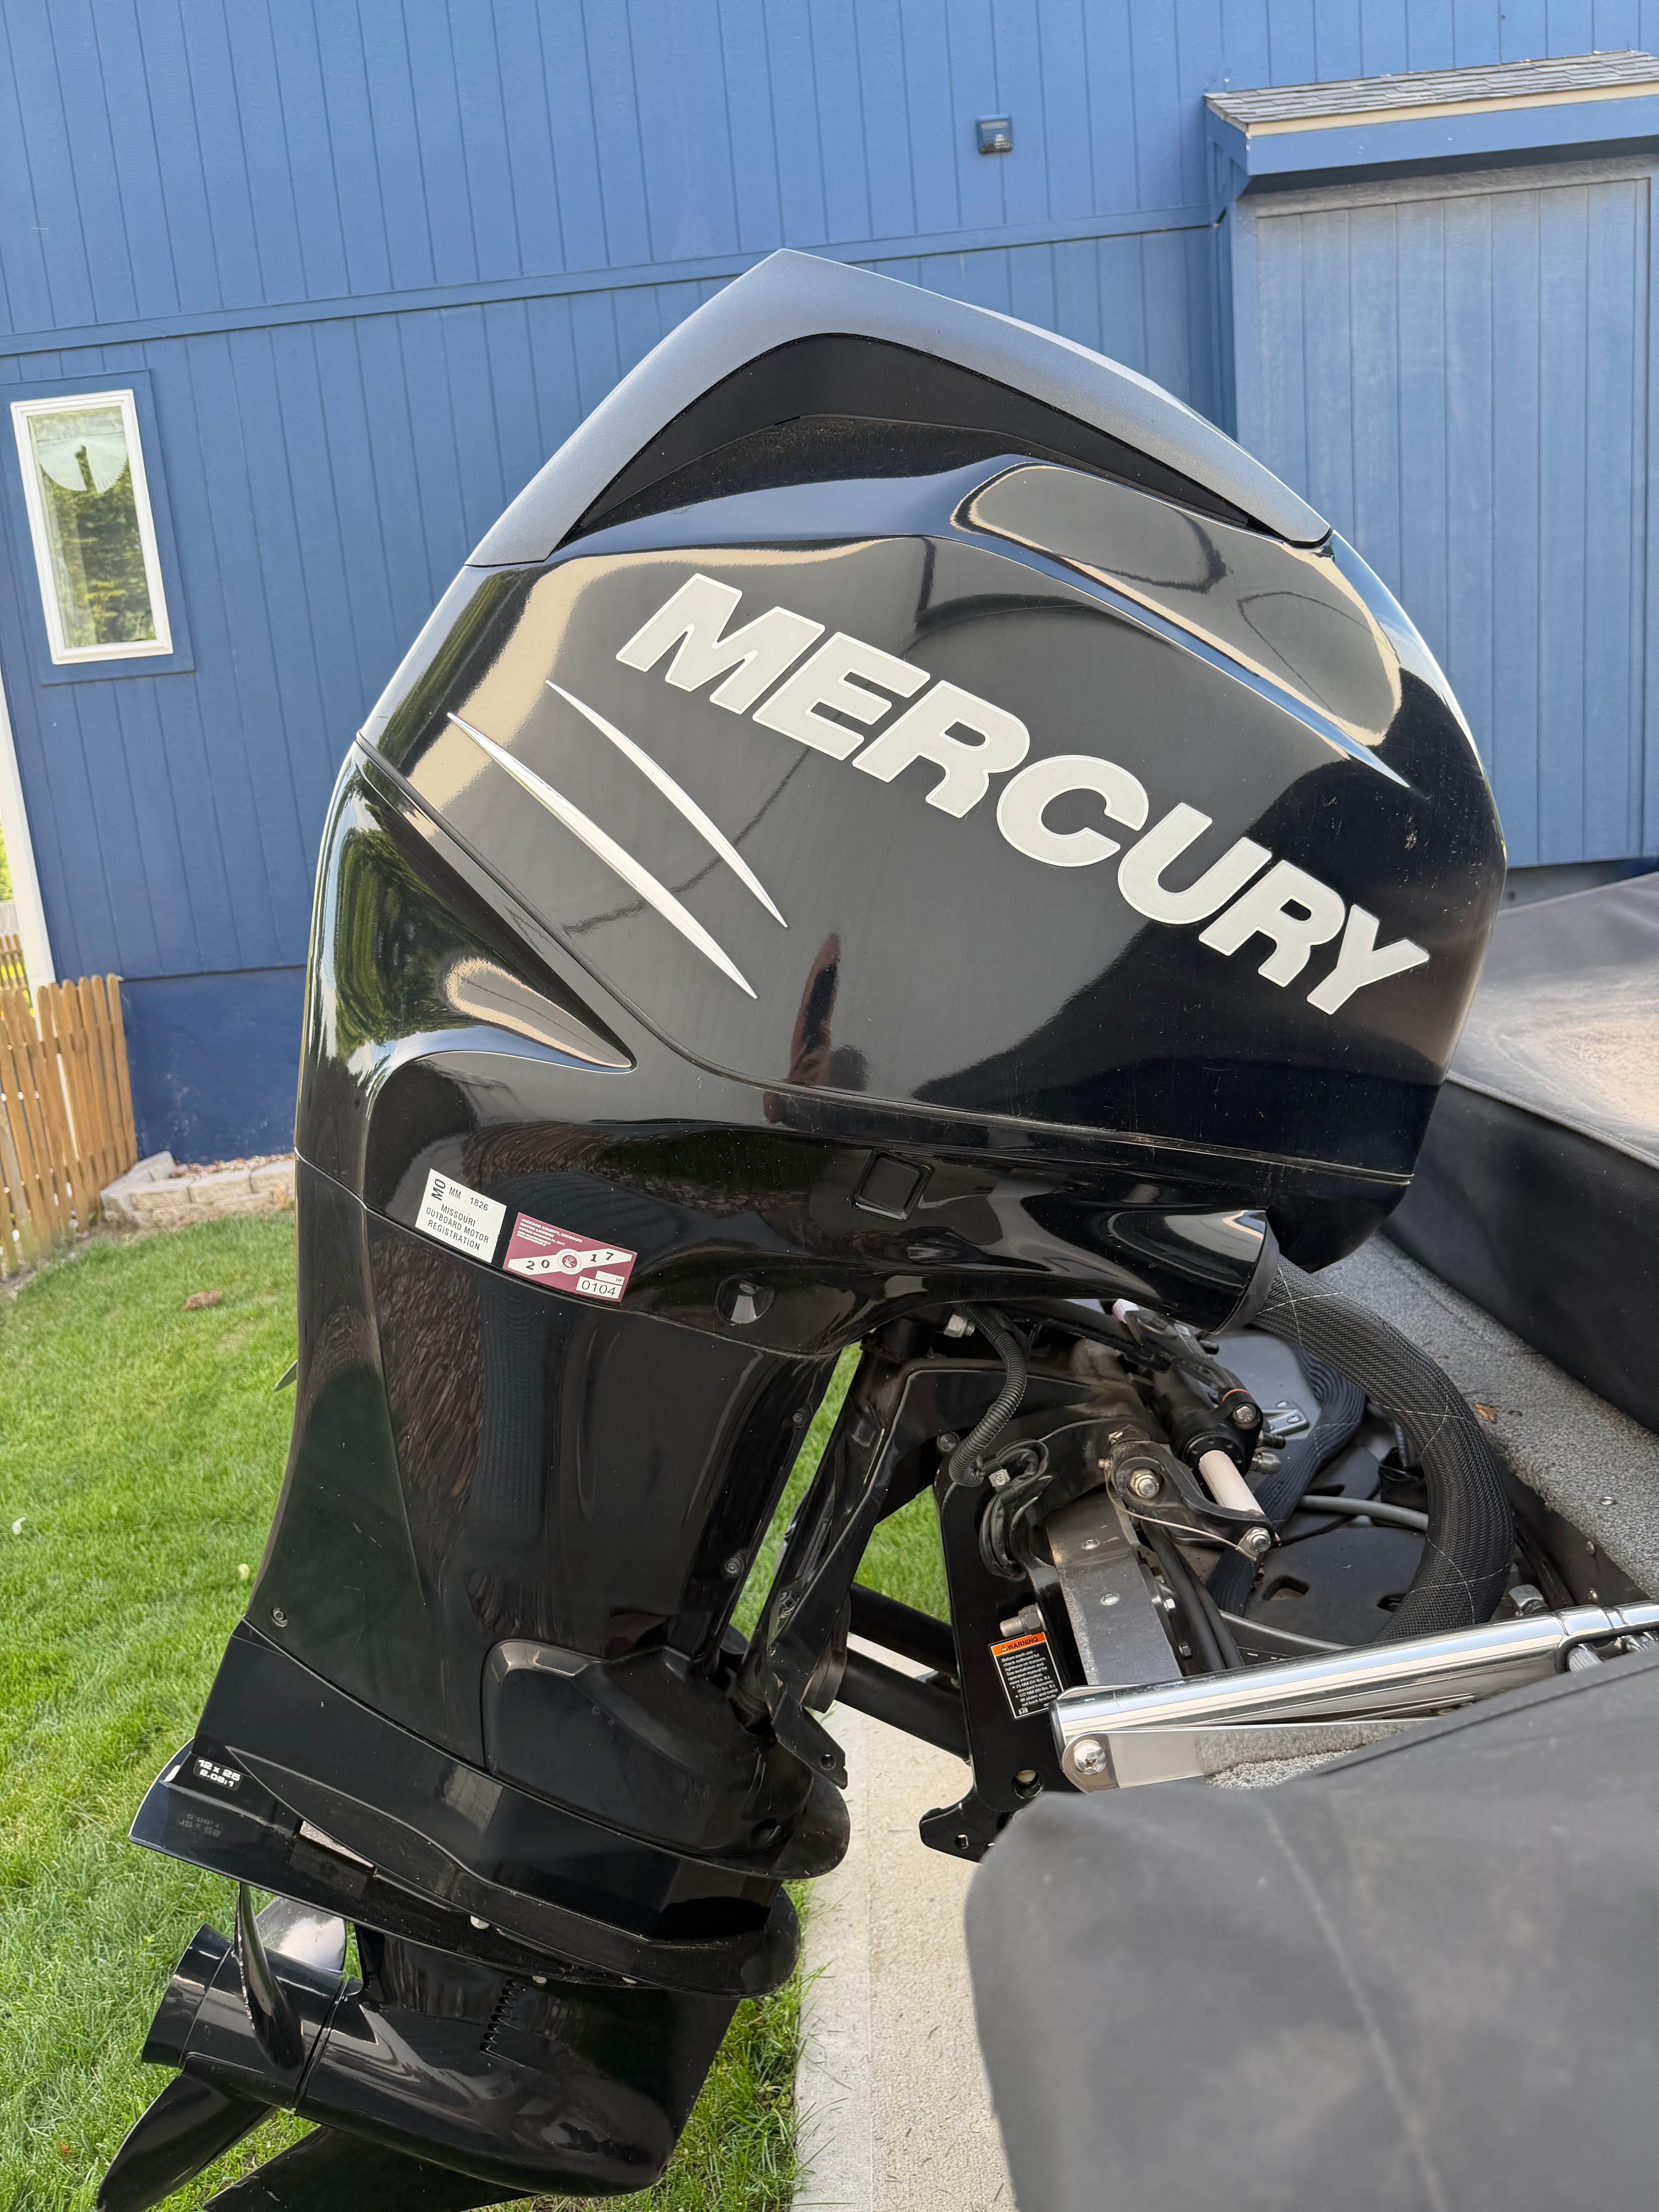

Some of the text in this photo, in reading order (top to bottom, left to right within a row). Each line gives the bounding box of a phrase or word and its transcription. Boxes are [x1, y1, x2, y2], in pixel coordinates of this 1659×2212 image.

[616, 573, 1430, 1015] MERCURY
[431, 1179, 446, 1201] MO
[449, 1187, 488, 1211] MM 1826
[426, 1207, 489, 1243] OUTBOARD MOTOR
[441, 1204, 476, 1227] MISSOURI
[428, 1219, 480, 1250] REGISTRATION
[520, 1222, 554, 1238] MOTOR LICENSE
[521, 1218, 582, 1243] JACKSON COUNTY, MISSOURI
[582, 1280, 616, 1296] 0104
[1007, 1637, 1038, 1650] WARNING
[198, 1760, 213, 1770] 12
[222, 1769, 240, 1781] 25
[200, 1769, 234, 1787] 2.08:1
